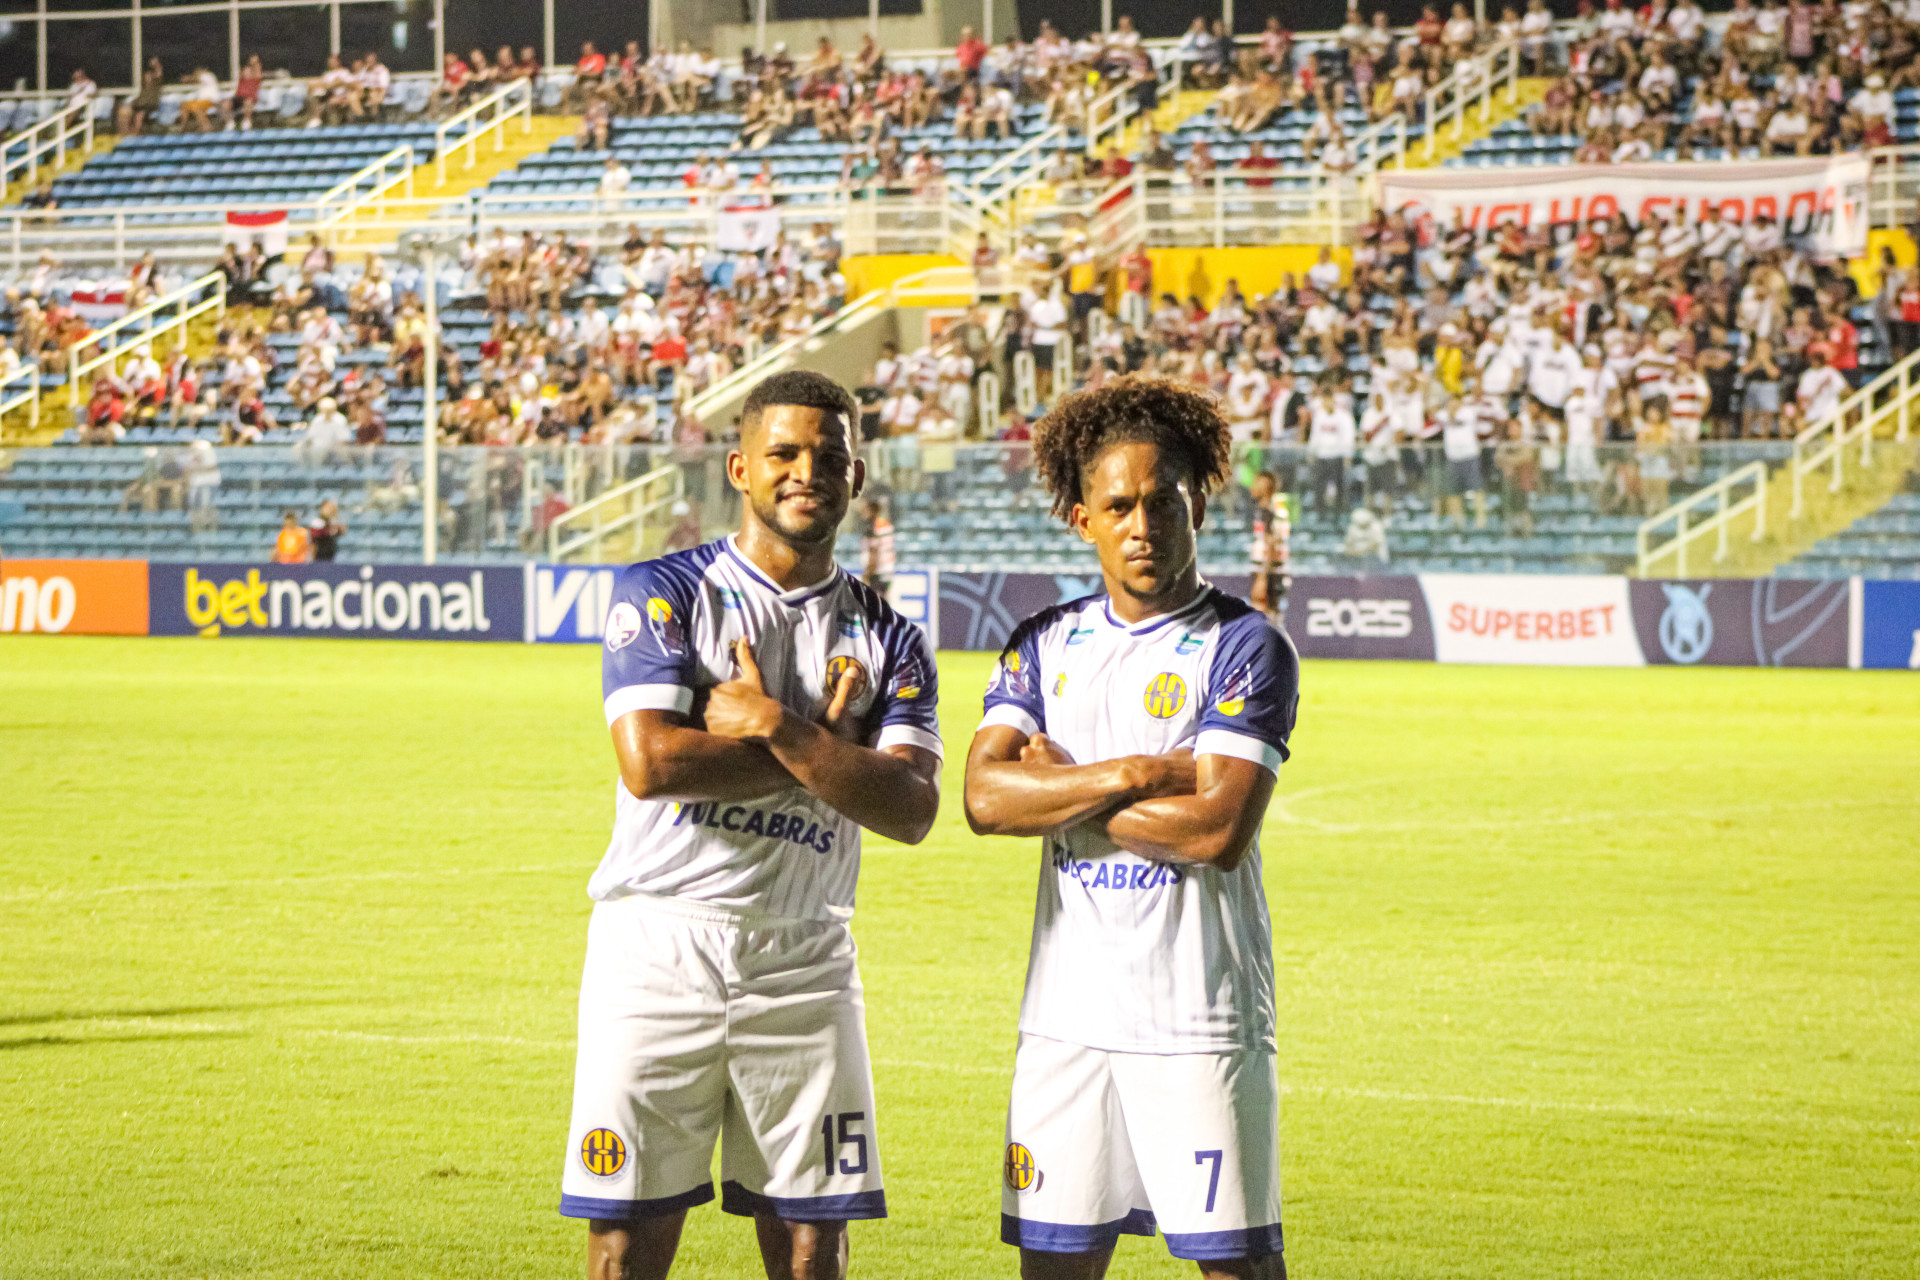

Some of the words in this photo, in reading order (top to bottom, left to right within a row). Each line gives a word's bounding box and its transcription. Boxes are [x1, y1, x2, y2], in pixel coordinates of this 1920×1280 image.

[0, 575, 76, 634] no
[185, 566, 491, 631] betnacional
[1306, 599, 1412, 637] 2025
[1448, 602, 1616, 640] SUPERBET
[821, 1111, 868, 1176] 15
[1195, 1150, 1223, 1212] 7
